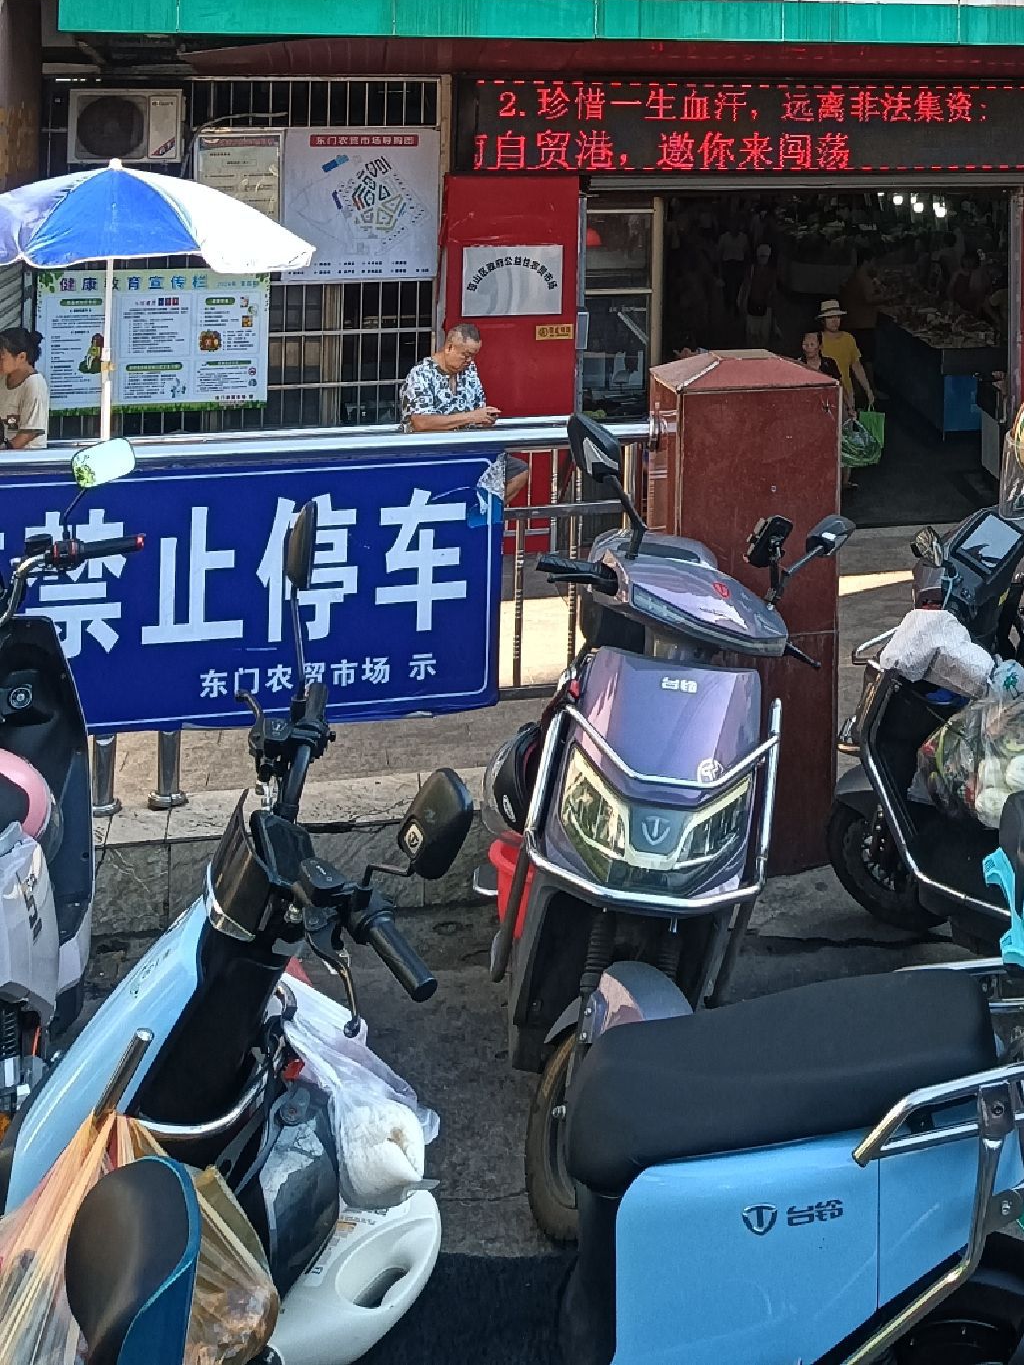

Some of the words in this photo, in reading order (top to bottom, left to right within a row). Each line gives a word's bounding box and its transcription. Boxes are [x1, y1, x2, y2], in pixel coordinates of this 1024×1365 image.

[200, 655, 391, 699] 东门农贸市场
[409, 653, 437, 681] 示
[786, 1198, 845, 1228] 台铃
